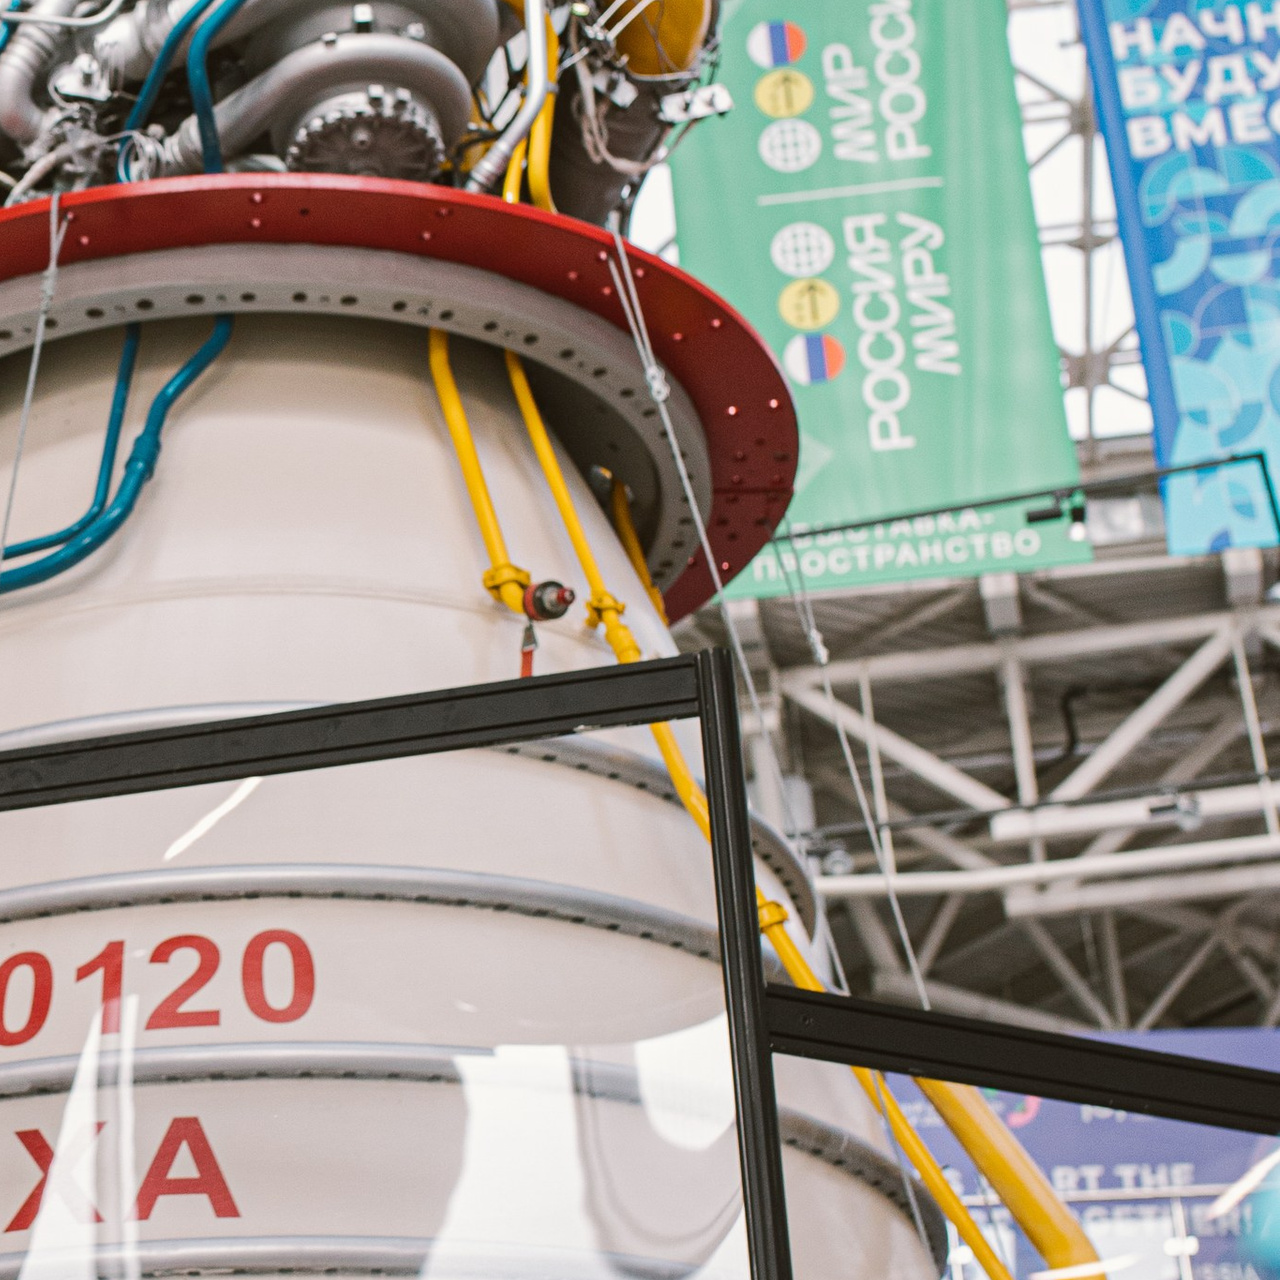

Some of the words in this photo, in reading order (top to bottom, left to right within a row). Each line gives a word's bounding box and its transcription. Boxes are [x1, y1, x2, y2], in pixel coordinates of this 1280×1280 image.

[822, 43, 879, 163] МИР
[843, 212, 917, 452] РОССИЯ
[896, 211, 962, 376] МИРУ
[752, 527, 1042, 582] ПРОСТРАНСТВО
